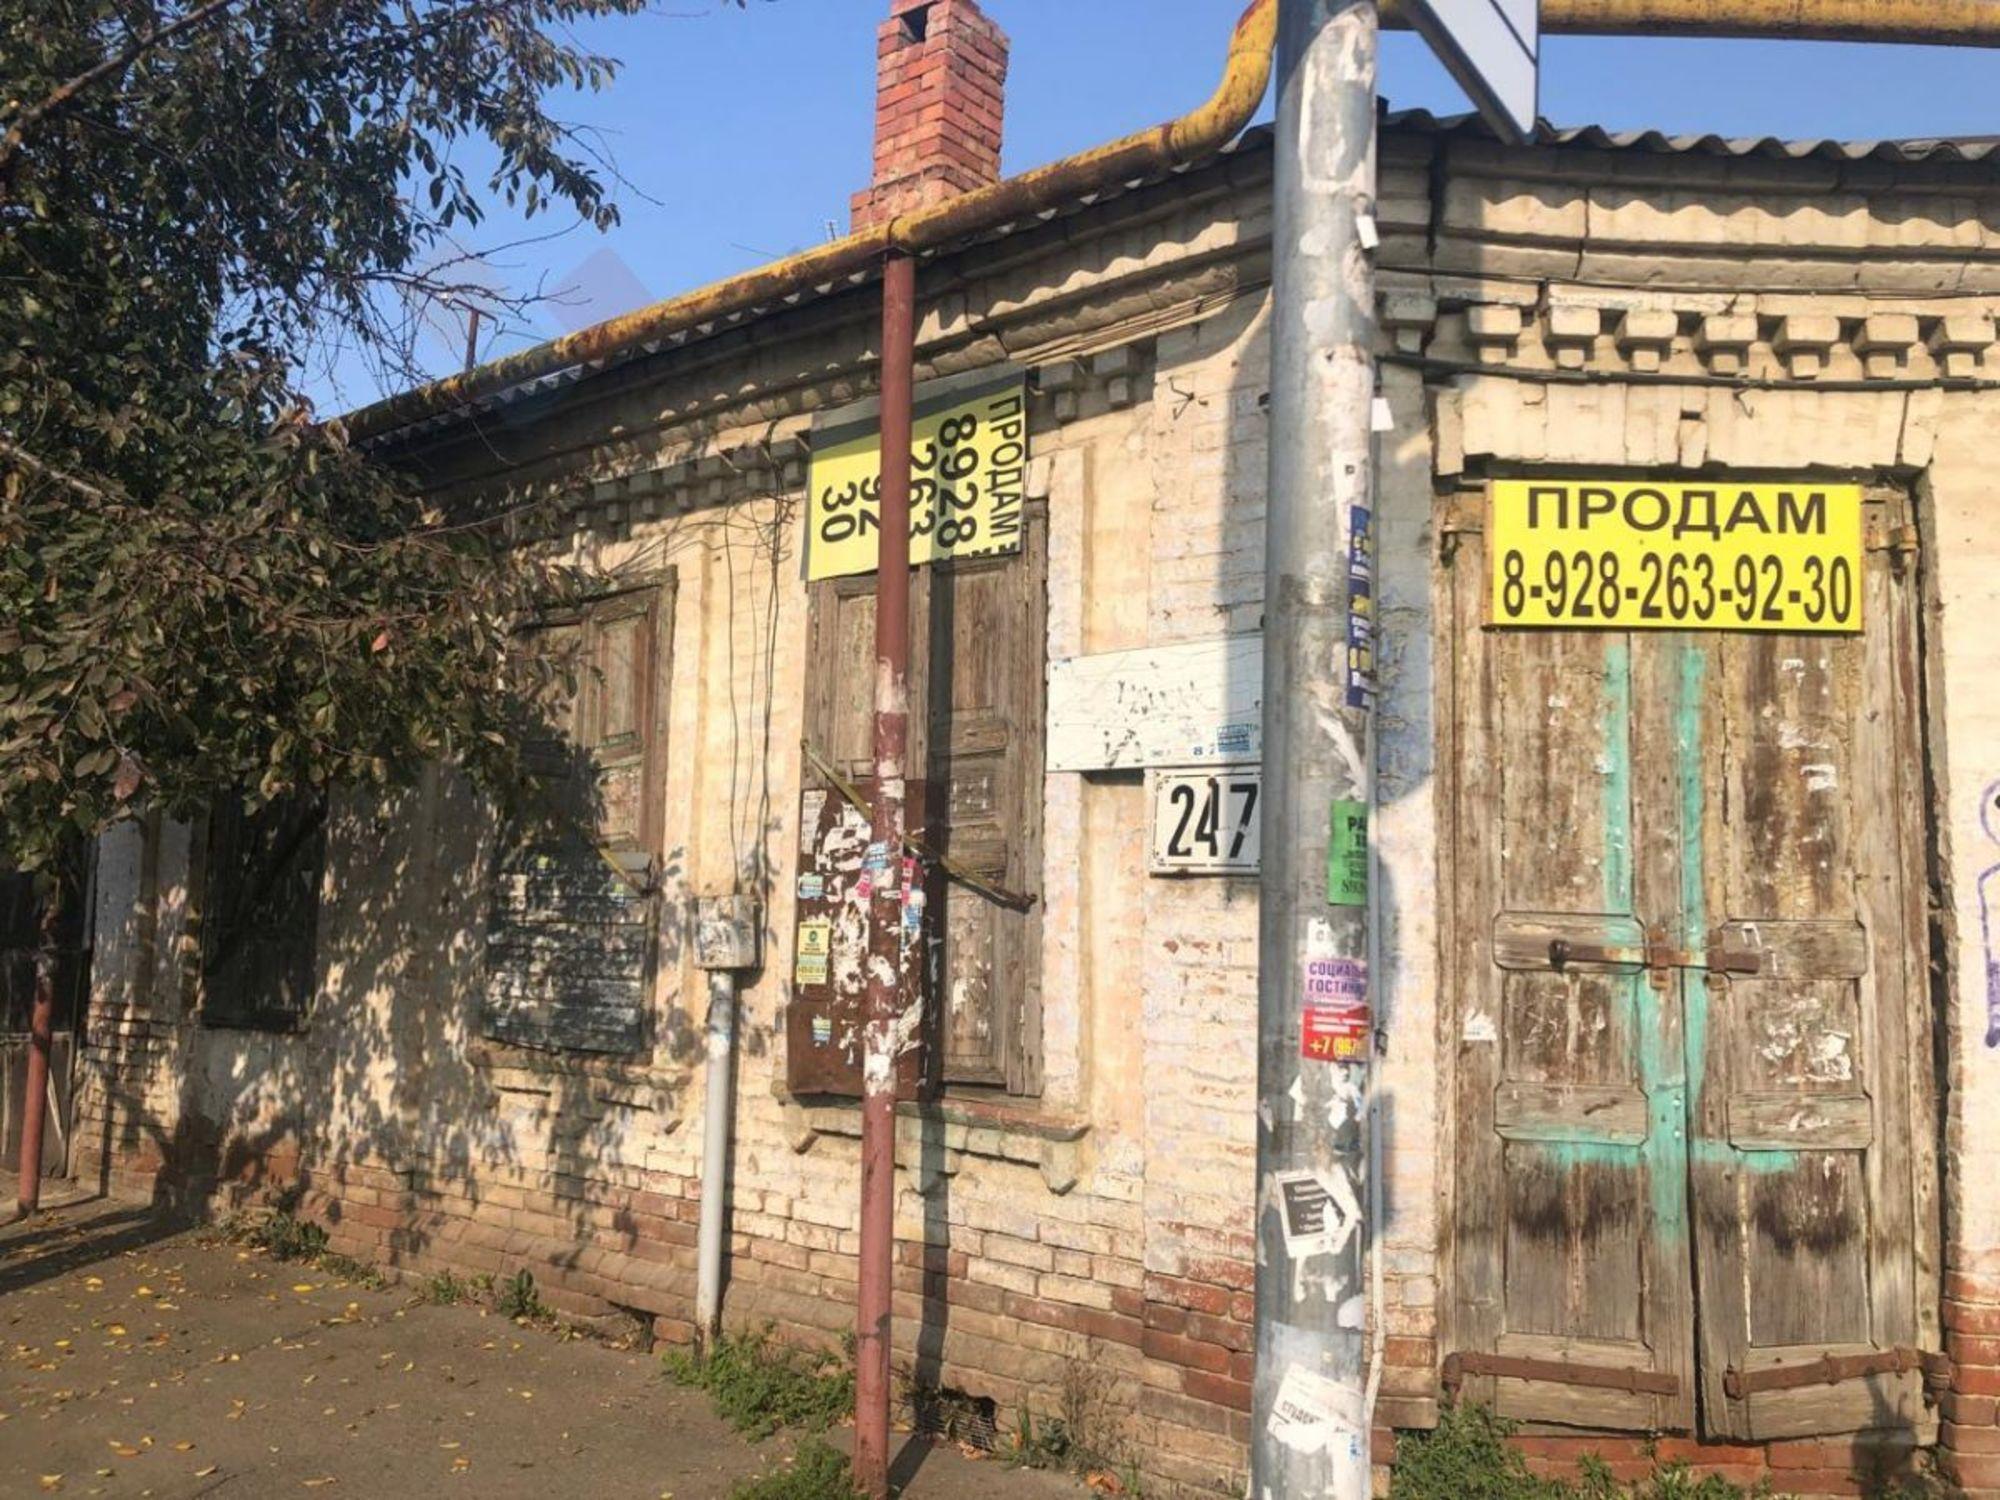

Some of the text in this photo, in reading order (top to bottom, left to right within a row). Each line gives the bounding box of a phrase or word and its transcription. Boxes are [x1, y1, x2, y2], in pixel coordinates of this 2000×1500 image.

[937, 413, 979, 548] 8928
[985, 394, 1023, 538] ПРОДАМ
[821, 481, 857, 543] 30
[1527, 486, 1826, 541] ПРОДАМ
[1503, 549, 1852, 623] 8-928-263-92-30
[1167, 781, 1259, 859] 247
